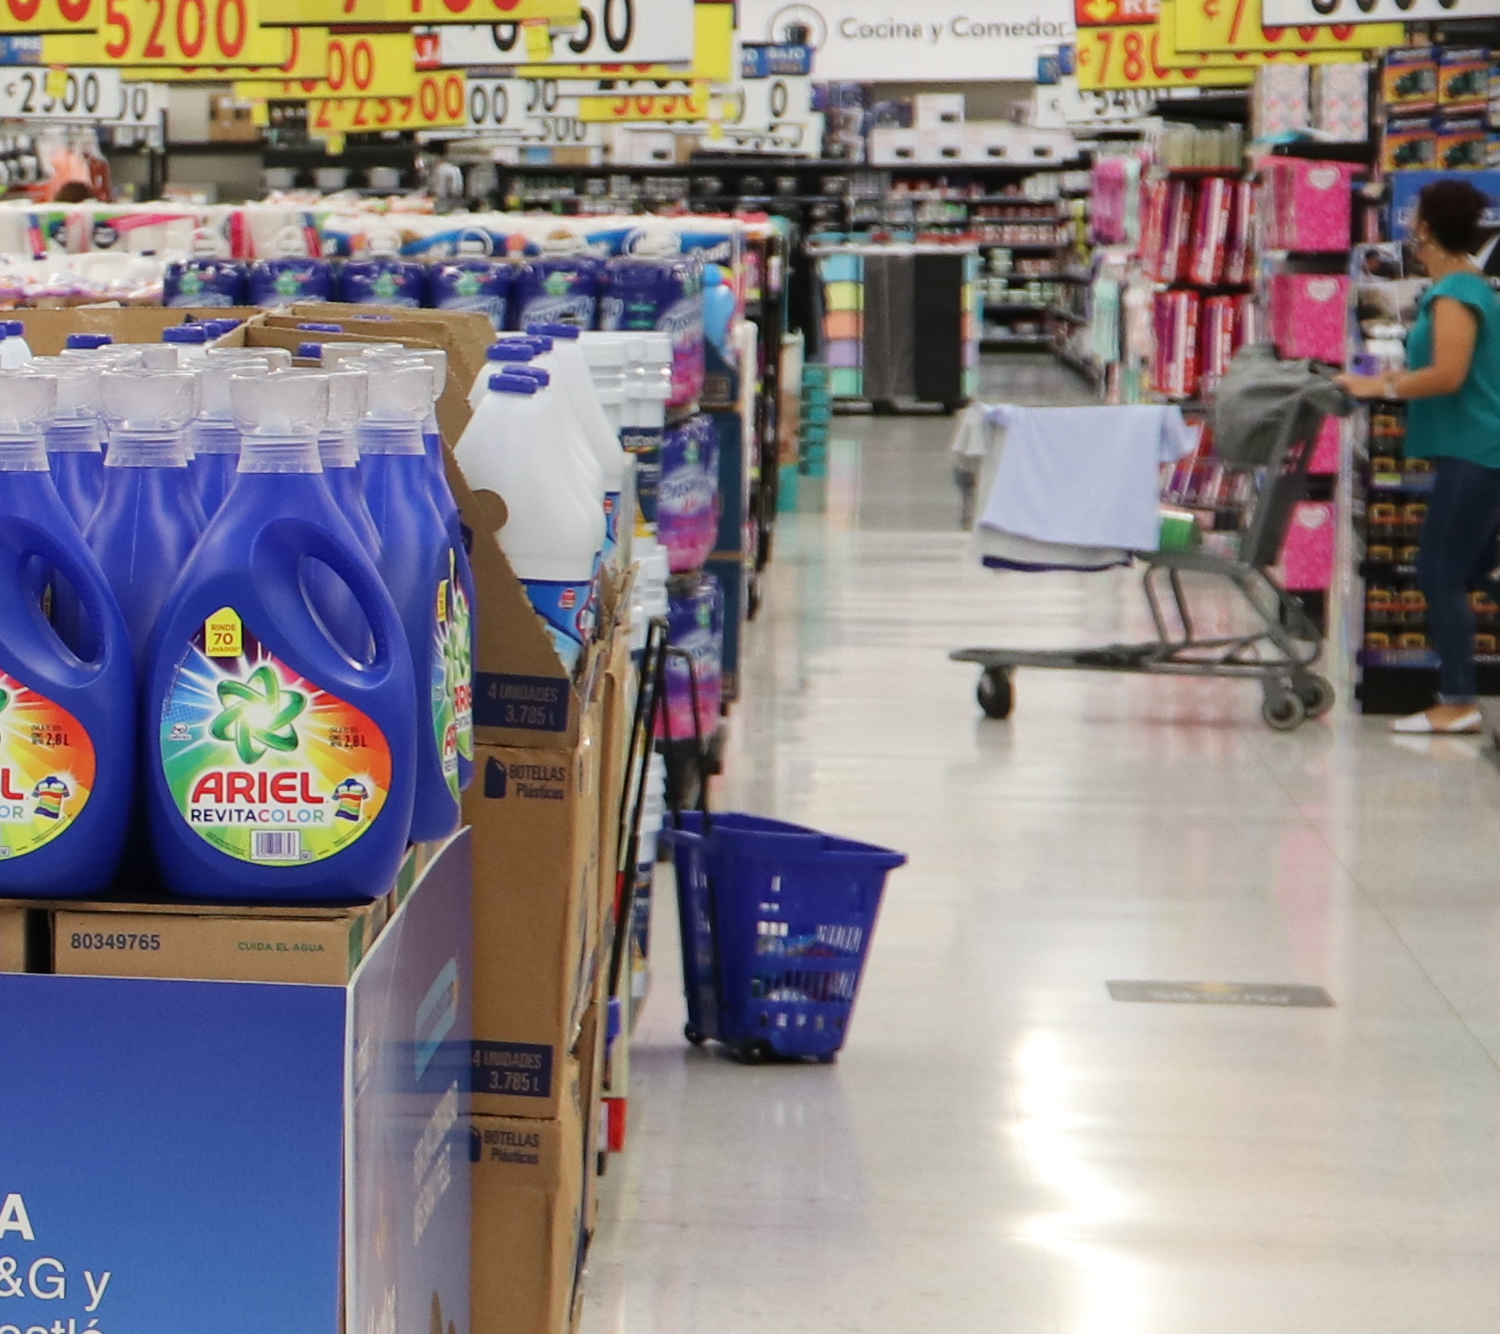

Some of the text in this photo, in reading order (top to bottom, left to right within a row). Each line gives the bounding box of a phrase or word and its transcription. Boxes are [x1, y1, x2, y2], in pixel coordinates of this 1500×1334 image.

[840, 13, 1066, 43] Cocina y Comedor
[509, 764, 565, 783] BOTELLAS
[70, 932, 161, 953] 80349765
[237, 940, 325, 954] CUIDA EL AGUA
[82, 1265, 112, 1311] y
